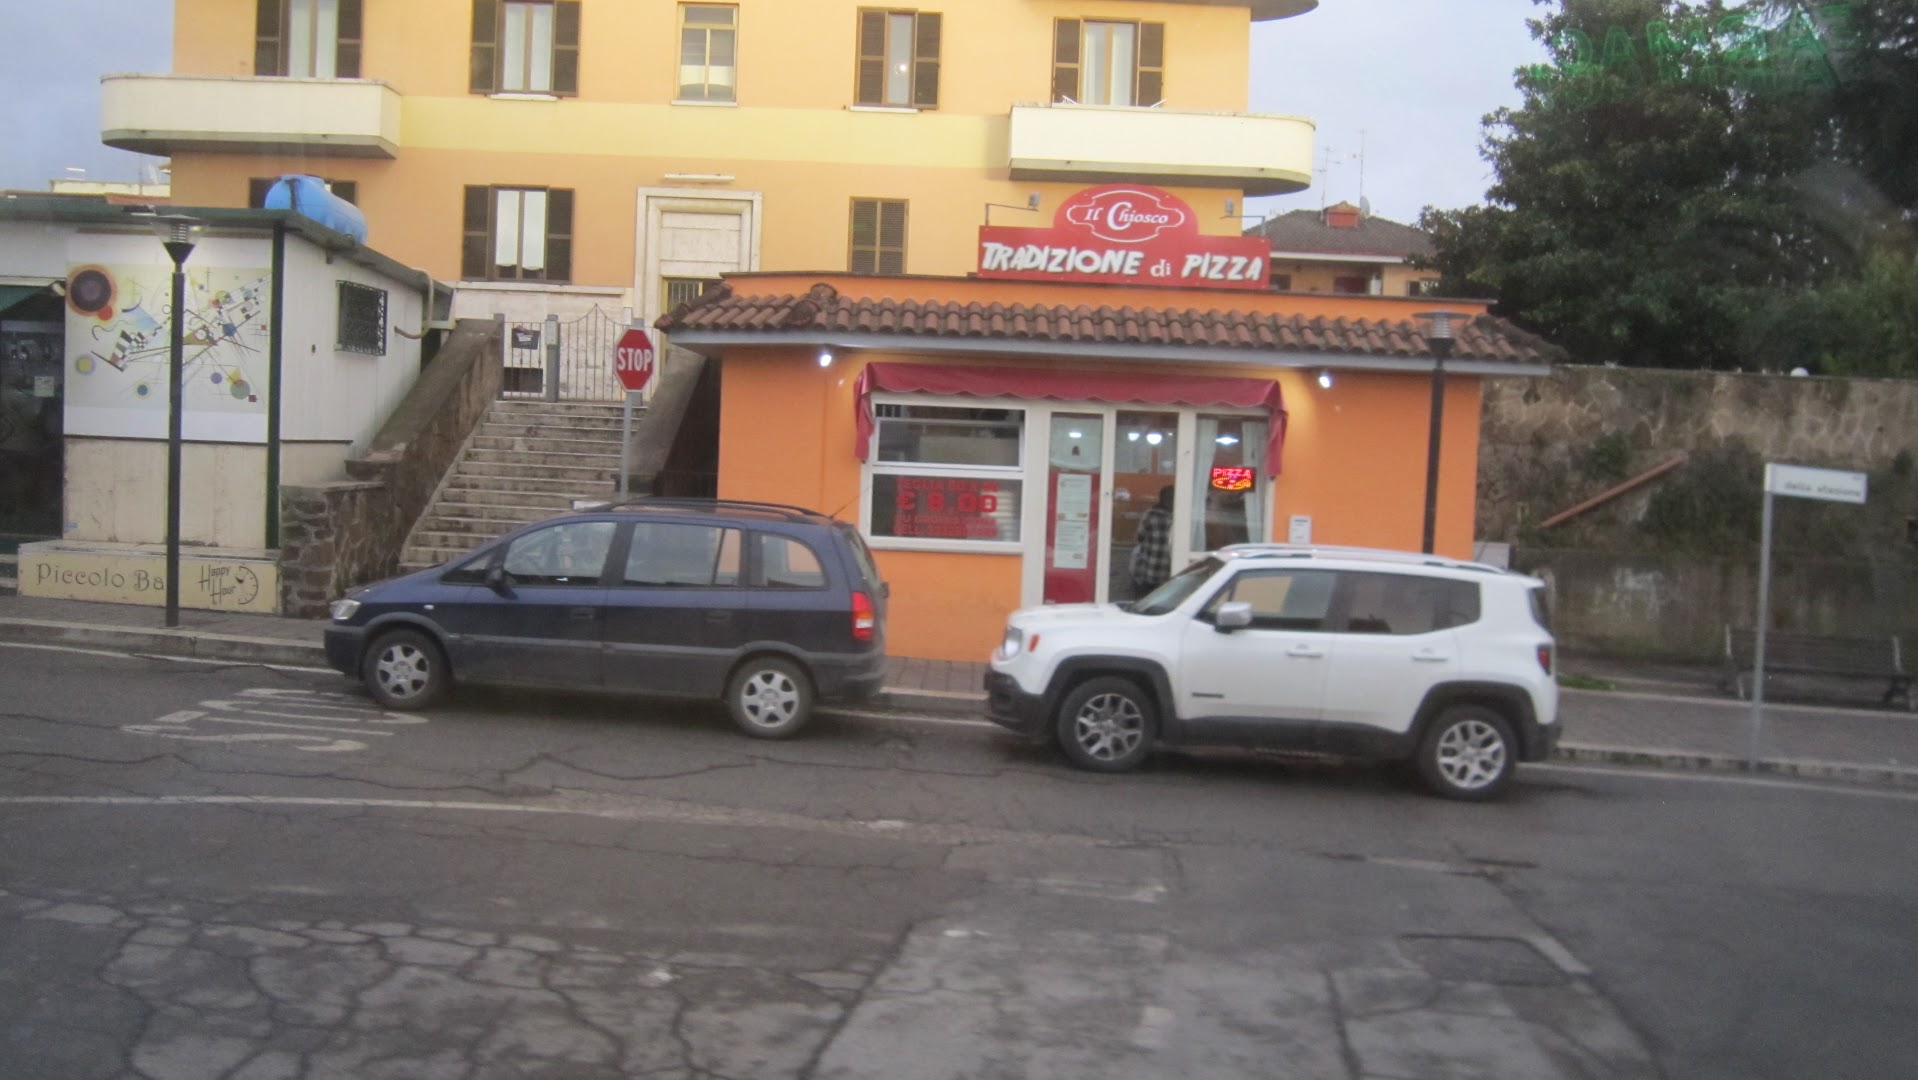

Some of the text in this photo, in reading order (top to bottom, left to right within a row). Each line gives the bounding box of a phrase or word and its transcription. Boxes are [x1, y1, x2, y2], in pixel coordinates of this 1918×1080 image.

[1084, 201, 1169, 231] Il Chiosco
[981, 242, 1264, 281] TRADIZIONE di PIZZA
[617, 348, 652, 371] STOP
[1213, 467, 1252, 479] PIZZA
[35, 562, 172, 592] Piccolo Ba
[198, 564, 231, 592] Happy
[210, 577, 237, 605] Hour
